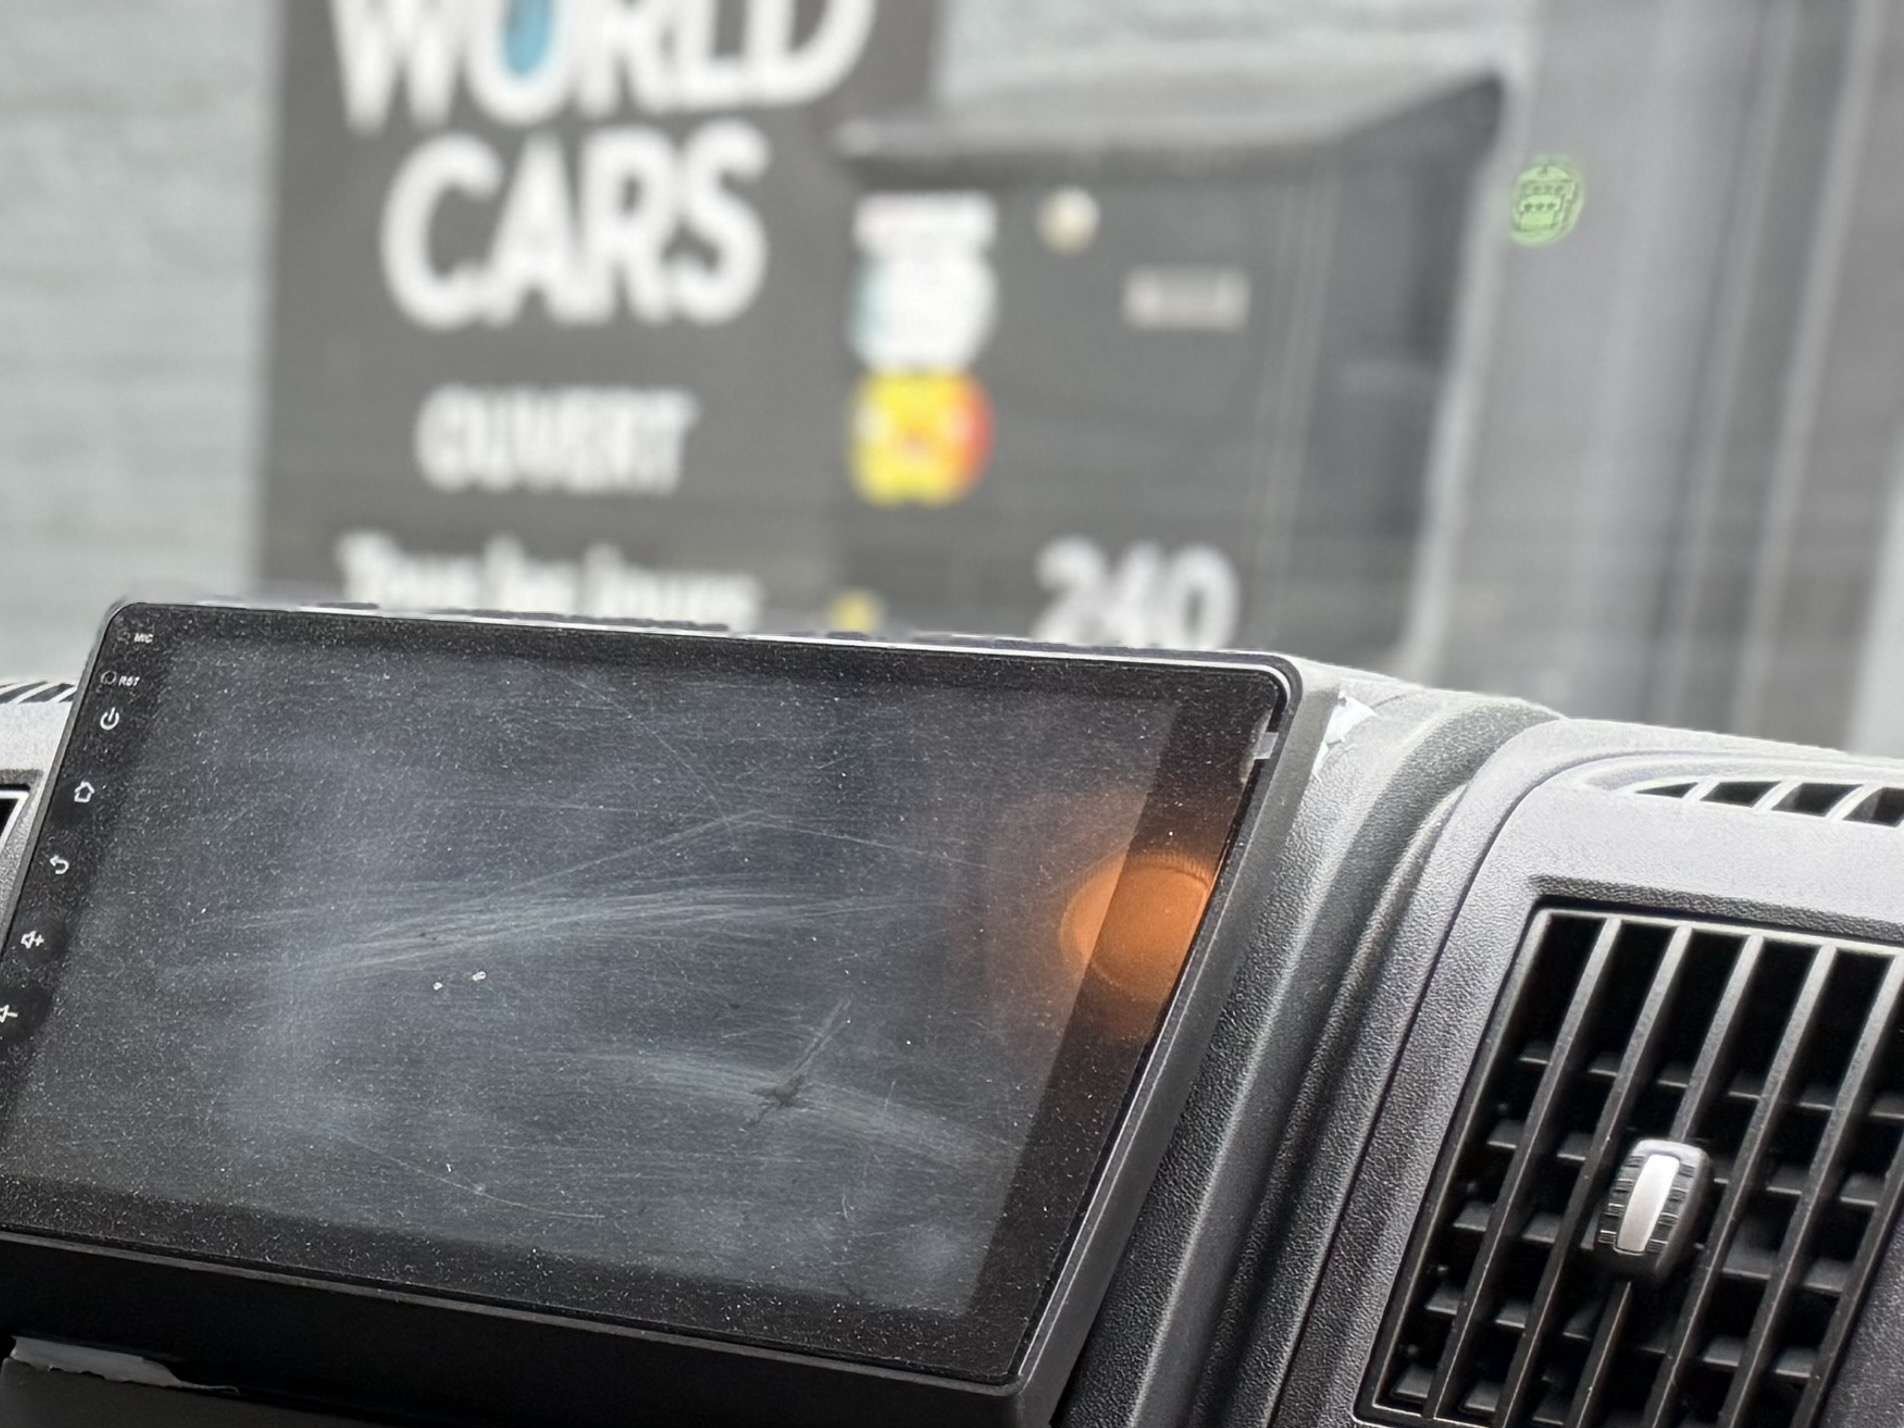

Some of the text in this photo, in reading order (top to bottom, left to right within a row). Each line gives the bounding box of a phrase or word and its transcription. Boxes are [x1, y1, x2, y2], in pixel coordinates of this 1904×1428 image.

[328, 0, 879, 134] WORLD
[380, 118, 770, 328] CARS
[415, 384, 700, 494] OUVERT
[118, 675, 141, 687] RST
[133, 632, 154, 644] MIC
